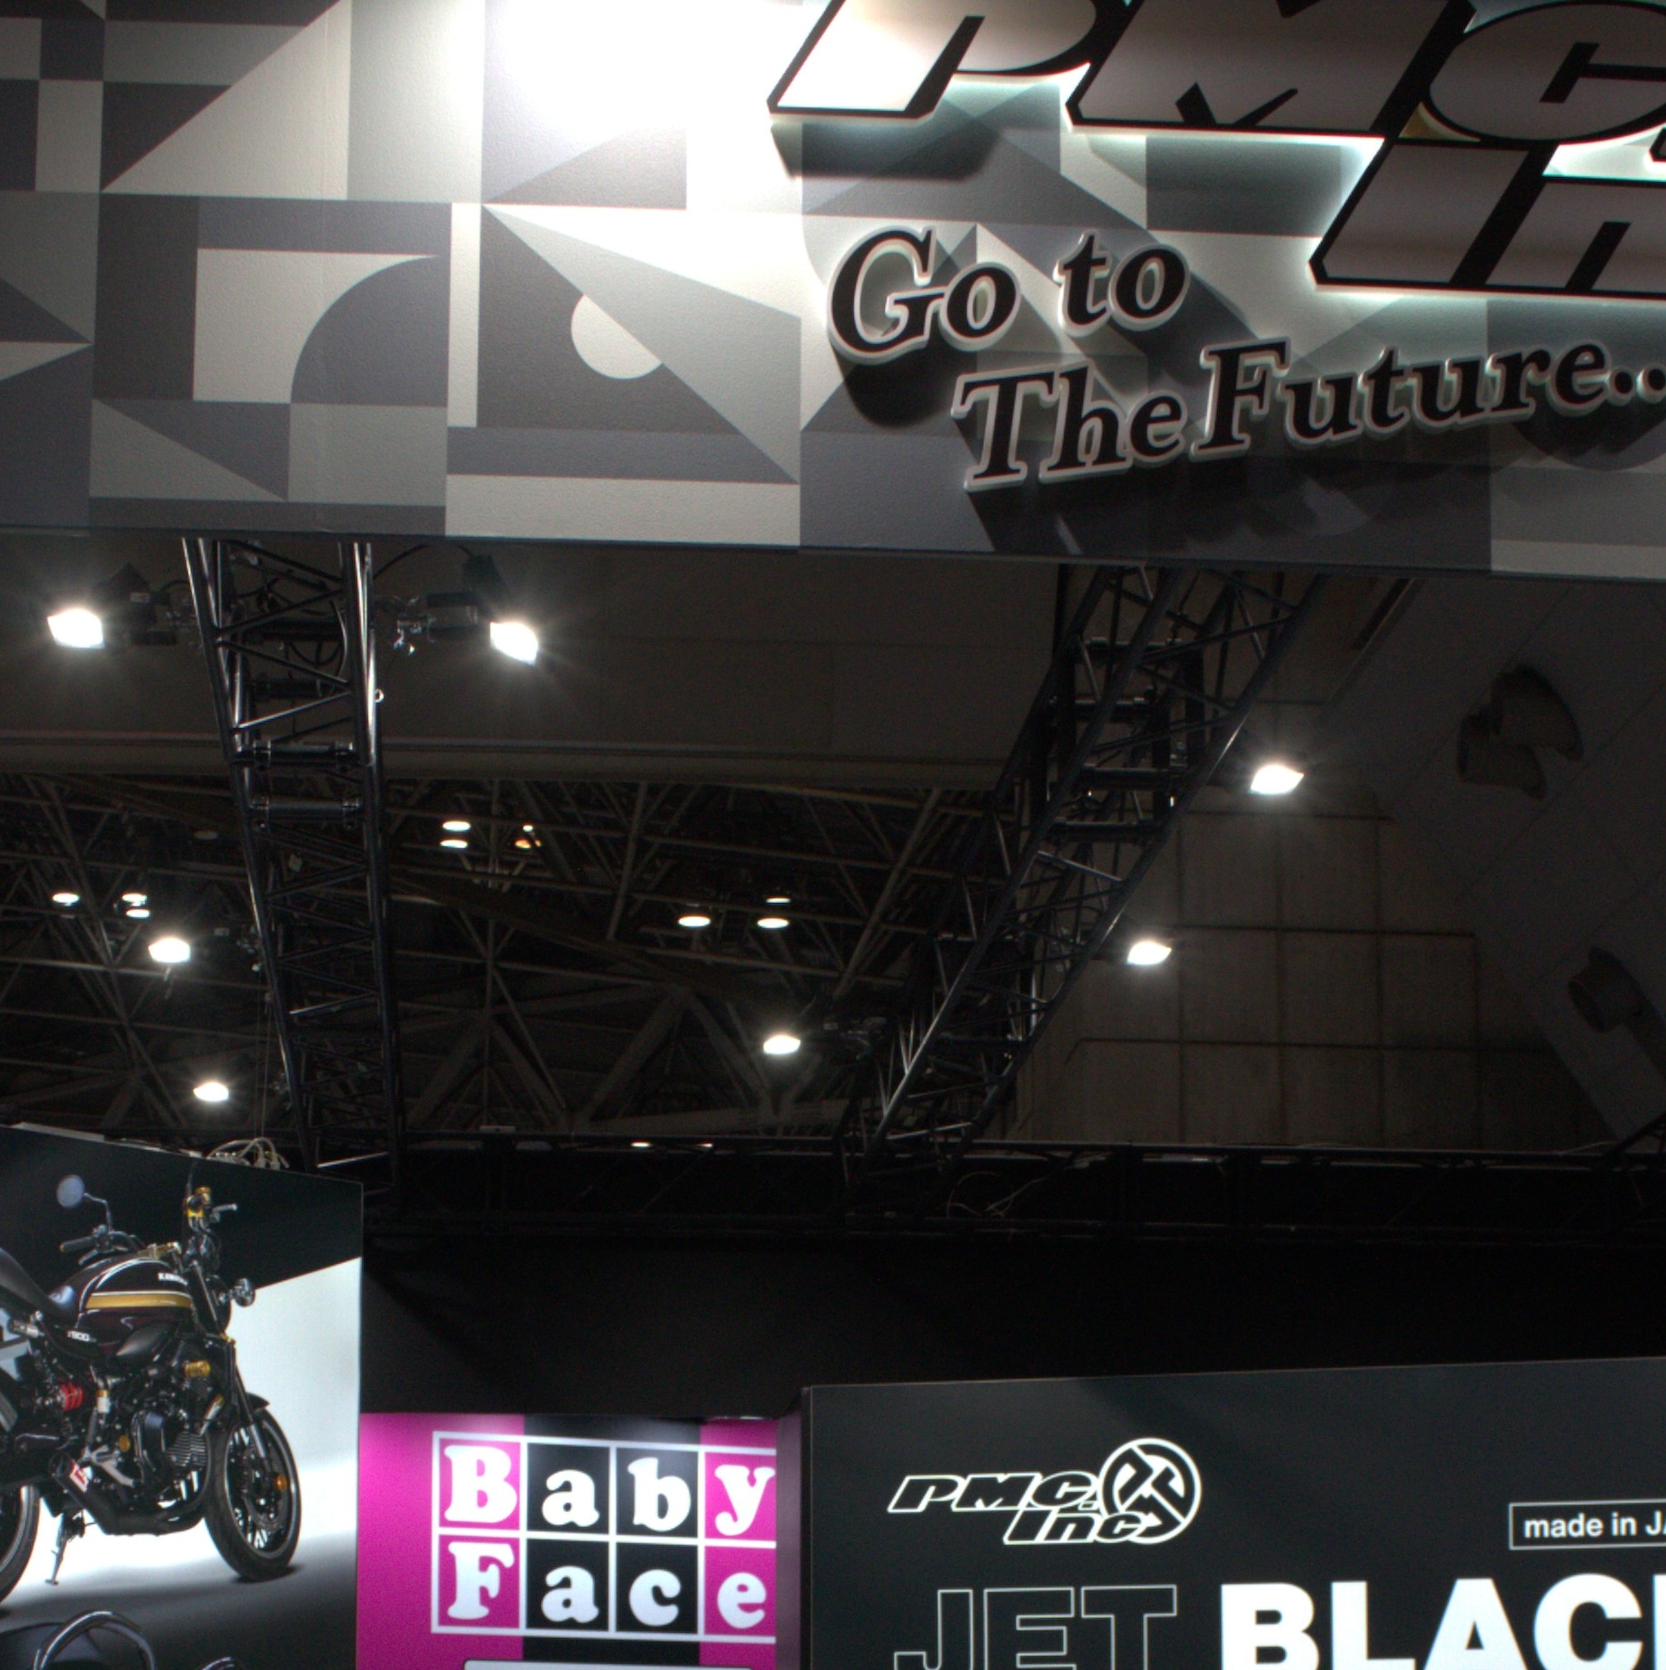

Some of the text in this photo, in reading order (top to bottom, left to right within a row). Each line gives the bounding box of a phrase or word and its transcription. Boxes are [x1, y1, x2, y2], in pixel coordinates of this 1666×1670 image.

[826, 226, 1191, 363] Go to
[444, 1445, 775, 1536] Baby
[1524, 1511, 1601, 1539] made
[1609, 1510, 1637, 1537] in
[447, 1543, 768, 1629] Face
